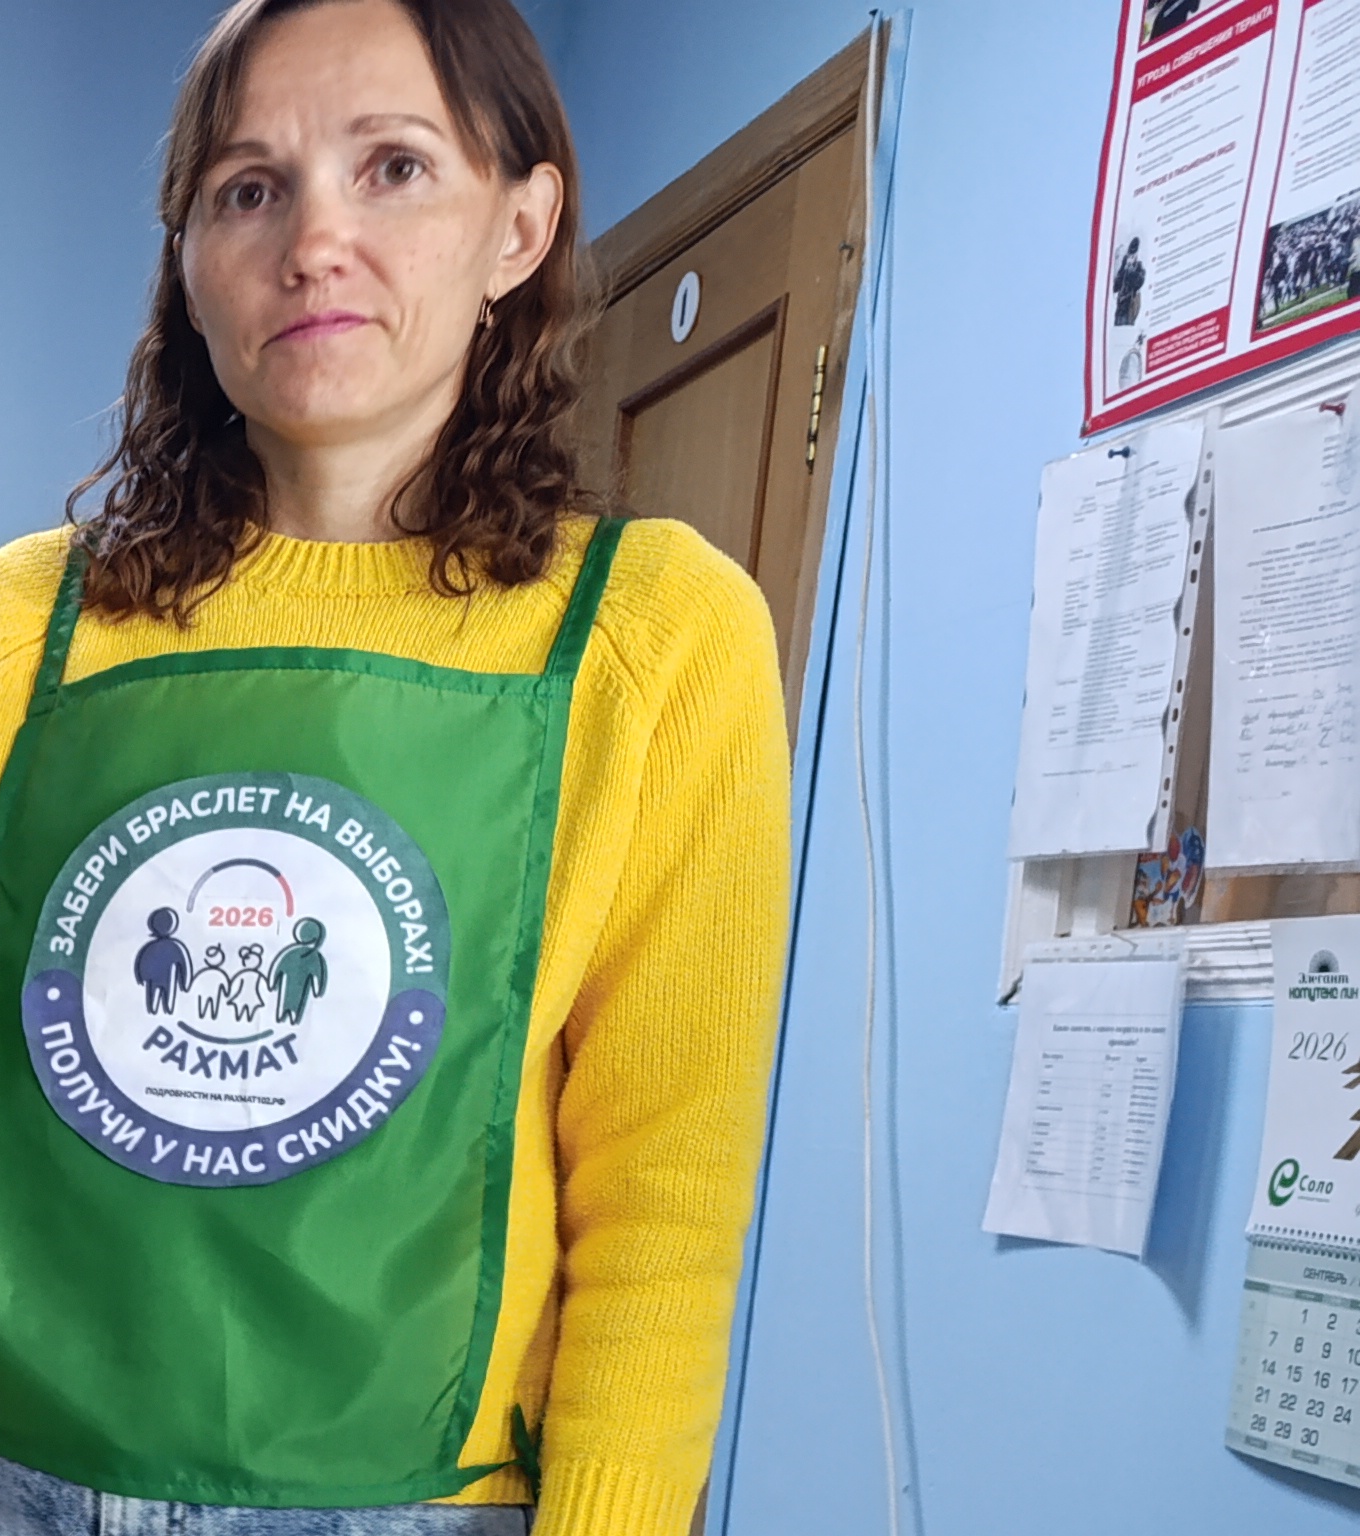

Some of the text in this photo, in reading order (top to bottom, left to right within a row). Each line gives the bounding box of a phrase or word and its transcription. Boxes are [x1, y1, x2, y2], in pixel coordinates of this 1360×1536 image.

[1136, 5, 1273, 91] УГРОЗА СОВЕРШЕНИЯ ТЕРАКТА
[49, 786, 434, 975] ЗАБЕРИ БРАСЛЕТ НА ВЫБОРАХ!
[207, 906, 274, 927] 2026
[142, 1025, 299, 1080] РАХМАТ
[1288, 1030, 1350, 1061] 2026
[41, 1021, 422, 1176] ПОЛУЧИ У НАС СКИДКУ!
[145, 1087, 208, 1101] ПОДРОБНОСТИ
[209, 1092, 223, 1102] НА
[1299, 1174, 1334, 1195] Соло
[1303, 1266, 1347, 1286] СЕНТЯБРЬ
[1301, 1309, 1337, 1331] 1 2
[1269, 1331, 1278, 1347] 7
[1294, 1336, 1304, 1354] 8
[1321, 1342, 1332, 1359] 9
[1261, 1358, 1359, 1395] 14 15 16 17
[1254, 1386, 1352, 1425] 21 22 23 24
[1250, 1413, 1319, 1447] 28 29 30
